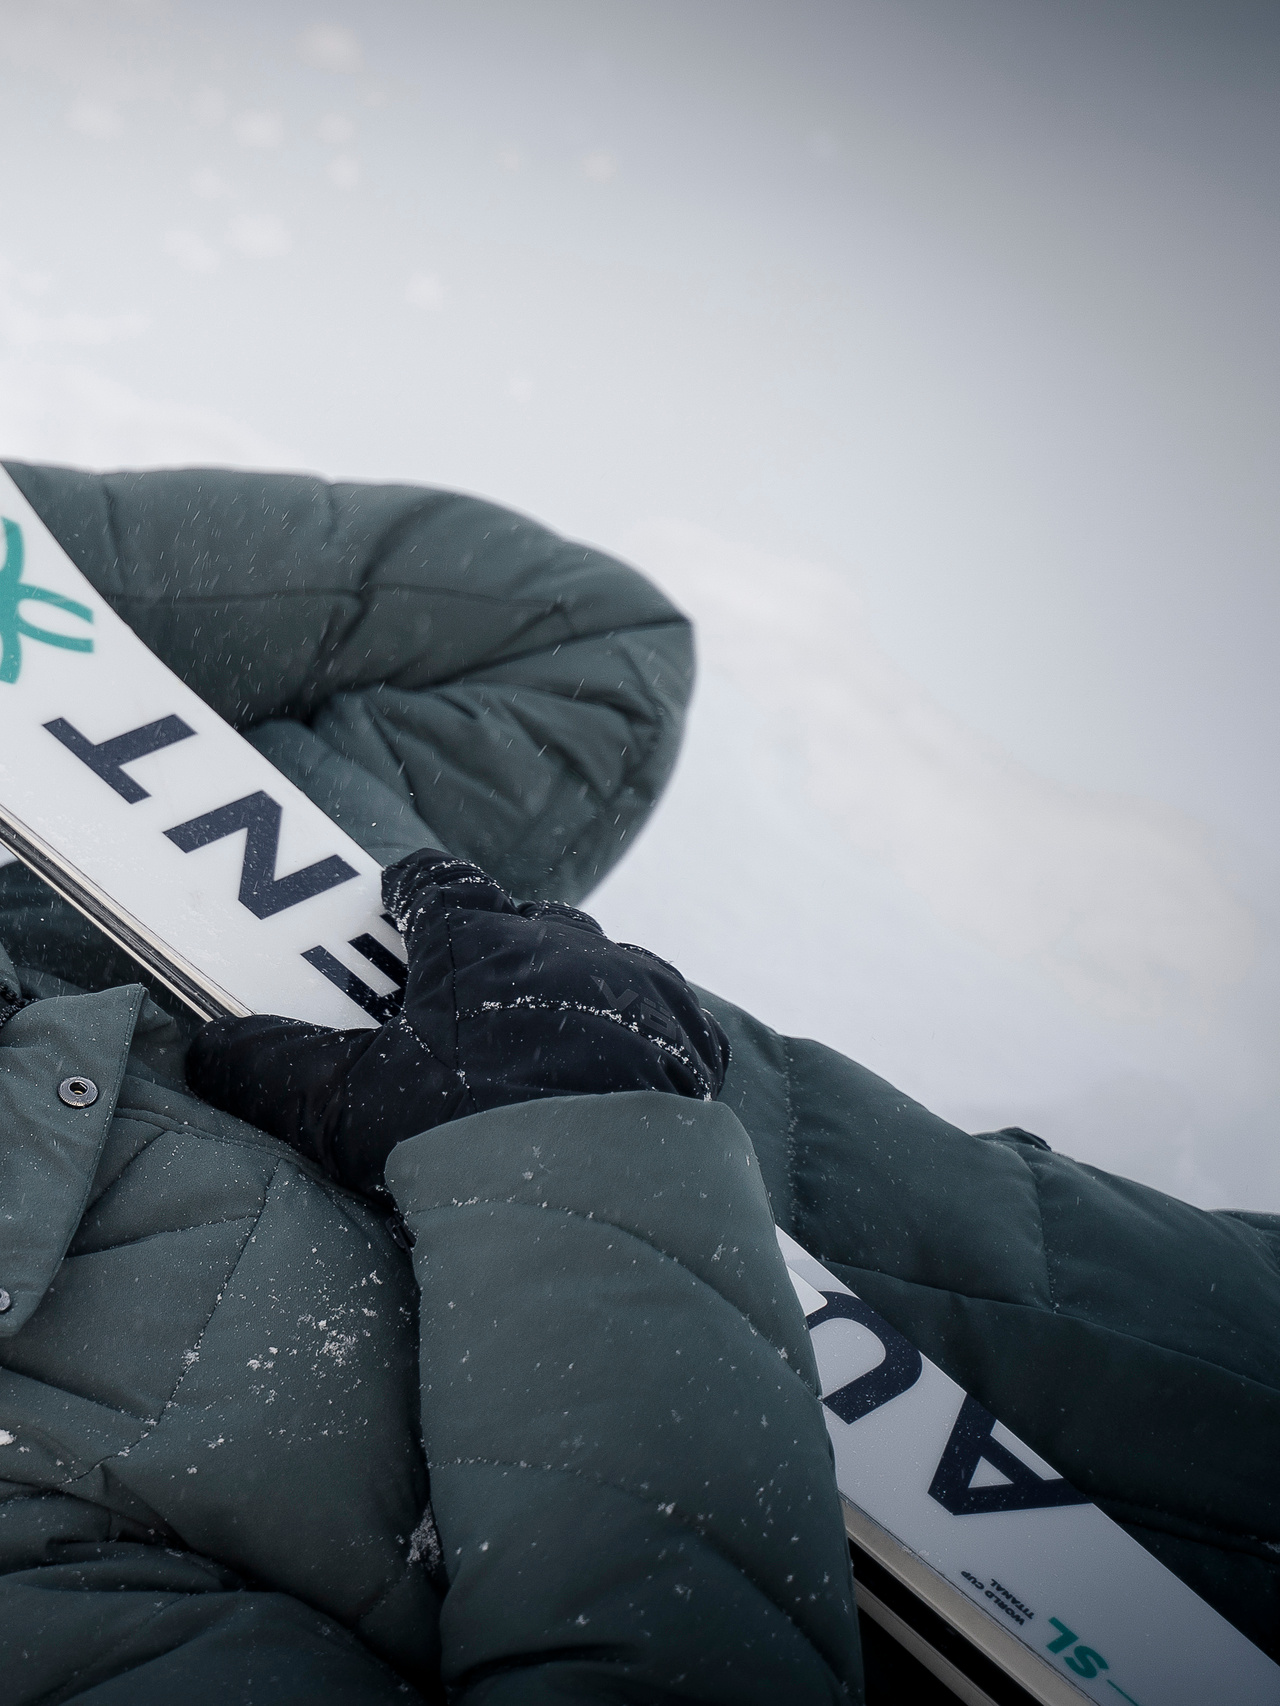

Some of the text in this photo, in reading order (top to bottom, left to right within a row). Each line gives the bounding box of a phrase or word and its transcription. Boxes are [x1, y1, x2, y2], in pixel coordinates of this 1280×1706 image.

[960, 1570, 1025, 1626] WORLD CUP
[990, 1578, 1035, 1620] TITANAL
[1046, 1616, 1109, 1679] SL
